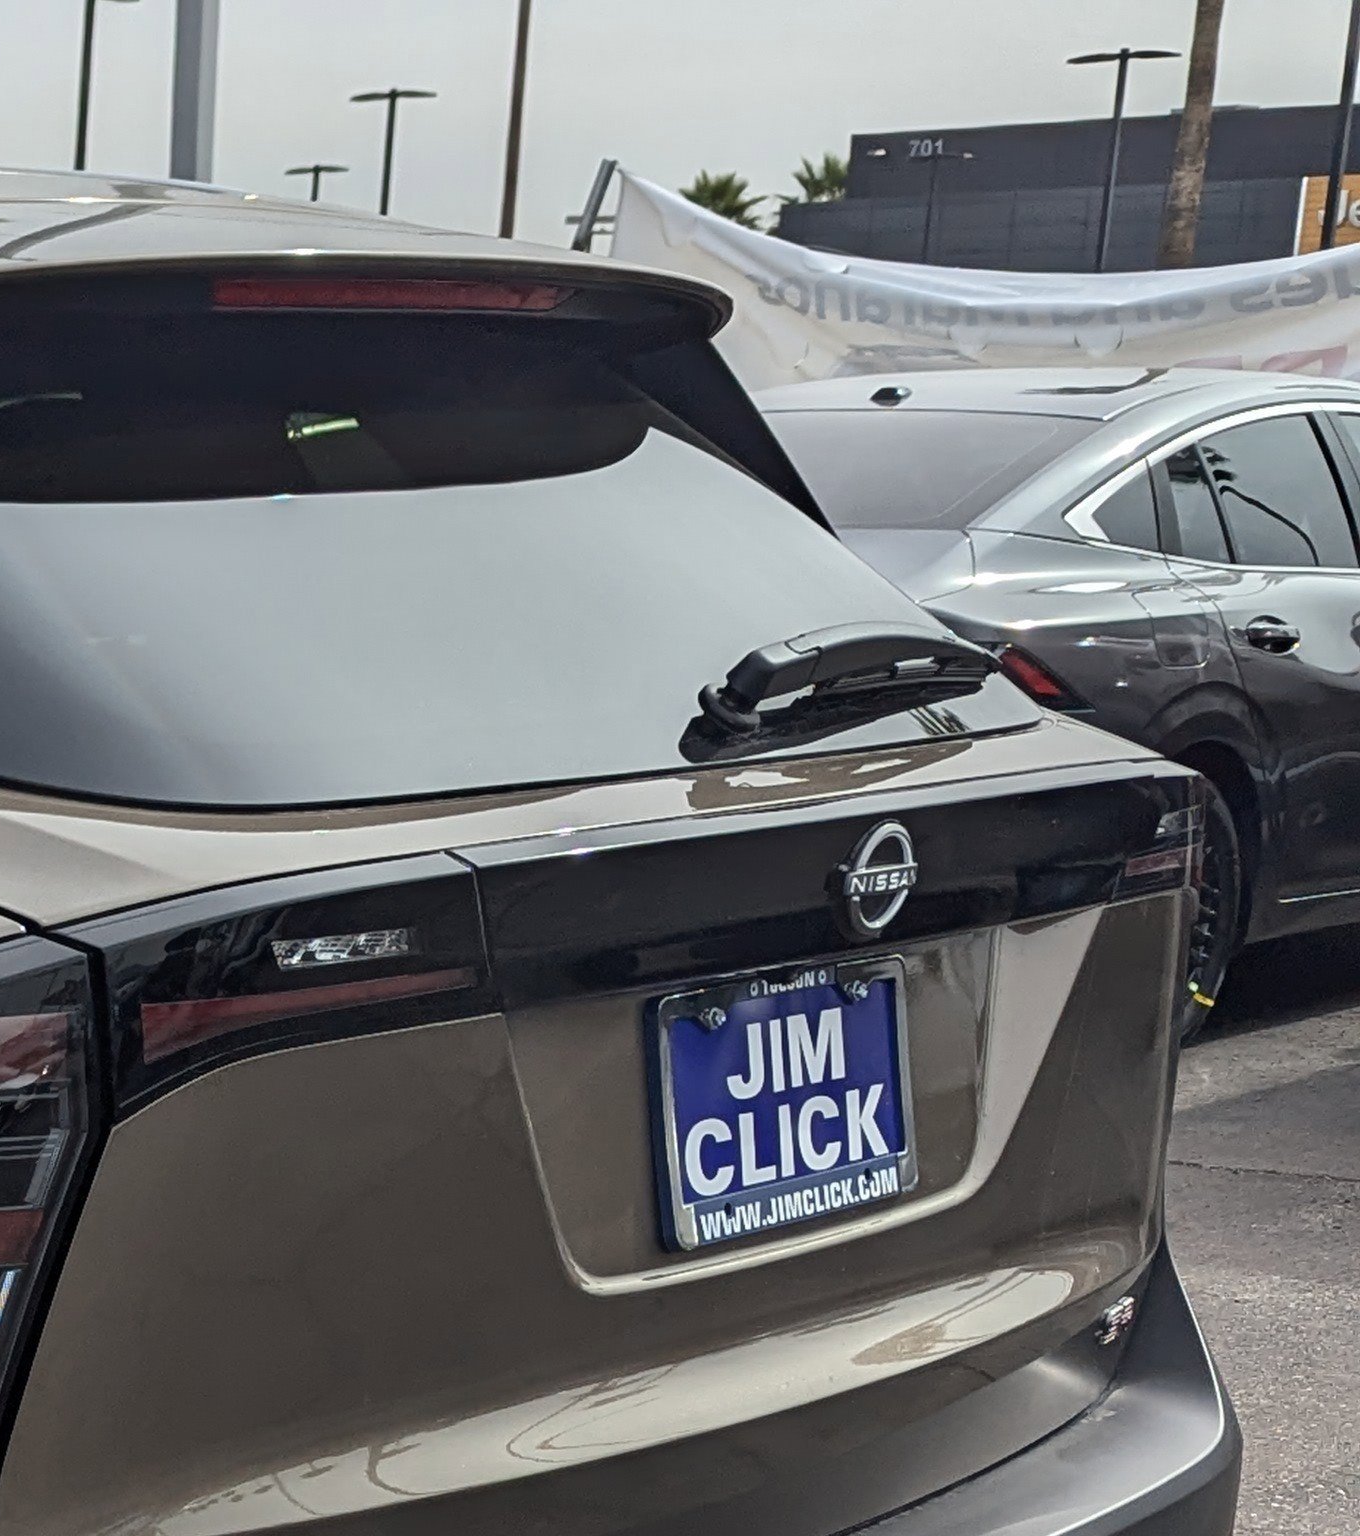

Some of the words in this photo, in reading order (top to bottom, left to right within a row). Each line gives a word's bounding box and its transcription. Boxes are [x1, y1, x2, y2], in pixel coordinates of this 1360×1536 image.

[909, 139, 943, 157] 701
[850, 868, 917, 893] NISSAN
[726, 1007, 846, 1100] JIM
[684, 1083, 890, 1197] CLICK
[699, 1166, 898, 1241] WWW.JIMCLICK.COM
